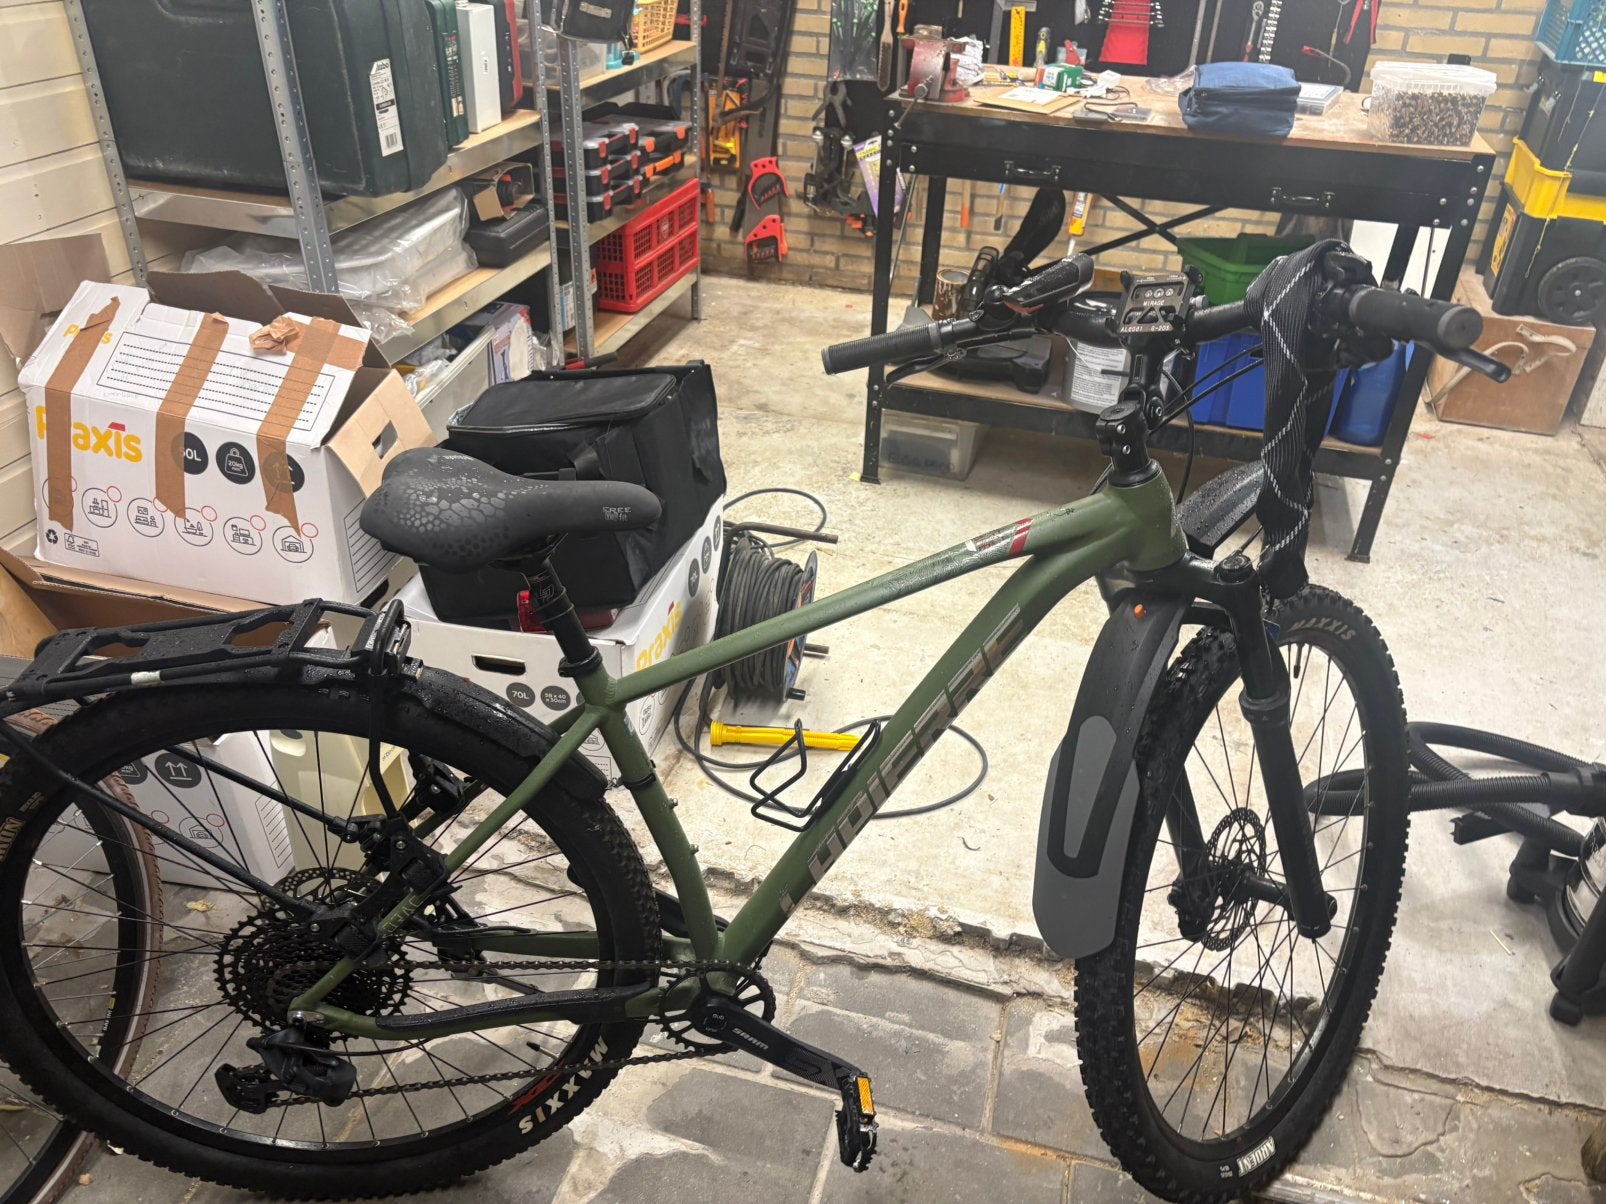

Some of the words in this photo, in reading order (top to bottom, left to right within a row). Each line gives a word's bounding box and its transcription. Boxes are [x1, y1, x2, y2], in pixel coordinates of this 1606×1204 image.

[35, 405, 143, 463] Paxis
[1286, 617, 1356, 640] MAXXIS
[511, 690, 530, 700] 70L
[731, 1027, 769, 1050] SRAM
[1236, 1135, 1276, 1177] ARDENT
